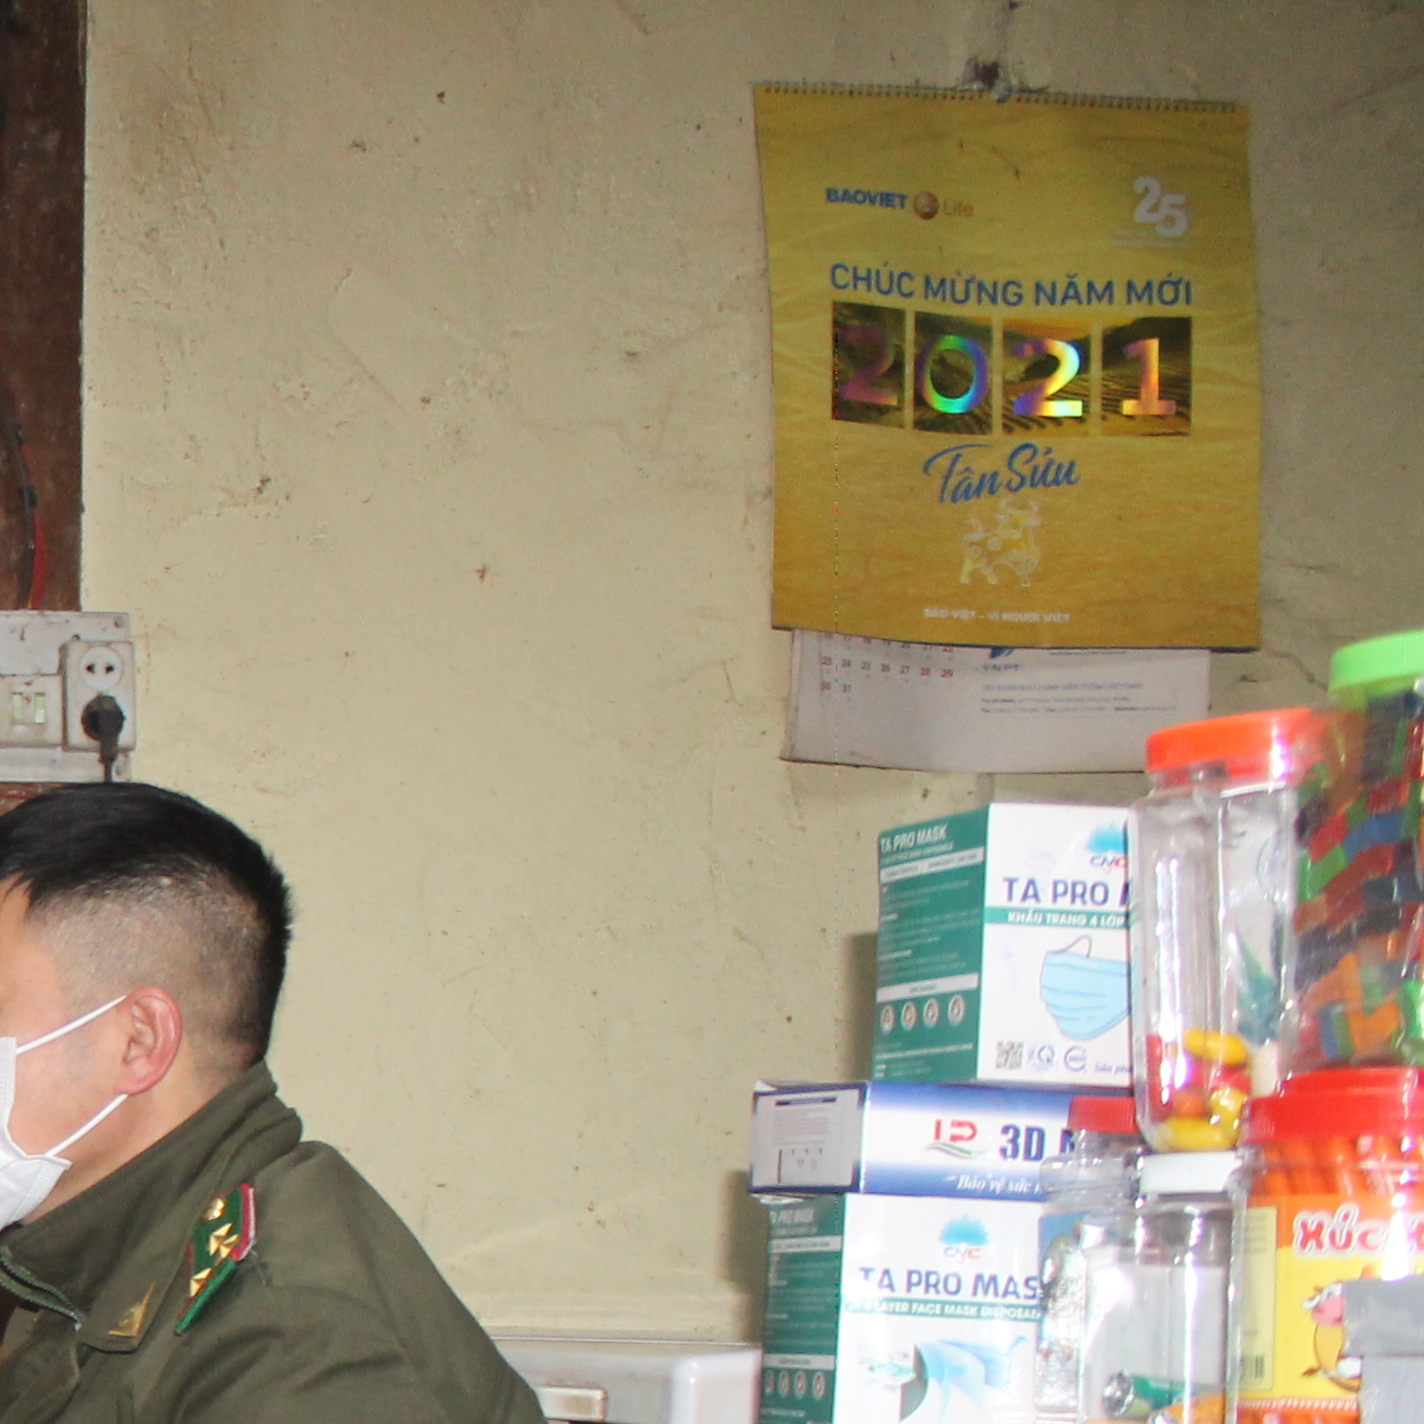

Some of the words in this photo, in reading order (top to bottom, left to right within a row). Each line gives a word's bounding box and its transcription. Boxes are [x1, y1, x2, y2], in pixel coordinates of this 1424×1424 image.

[826, 187, 909, 210] BAOVIET
[1133, 176, 1190, 238] 25
[831, 261, 915, 297] CHÚC
[924, 268, 1024, 307] MỪNG
[1035, 273, 1114, 307] NĂM
[1126, 272, 1193, 306] MỚI
[923, 443, 1004, 504] Tân
[1003, 876, 1042, 904] TA
[1051, 878, 1110, 907] PRO
[1000, 1124, 1045, 1161] 3D
[906, 1269, 962, 1296] PRO
[970, 1273, 1043, 1300] MAS
[911, 1301, 942, 1315] FACE
[944, 1303, 978, 1317] MASK
